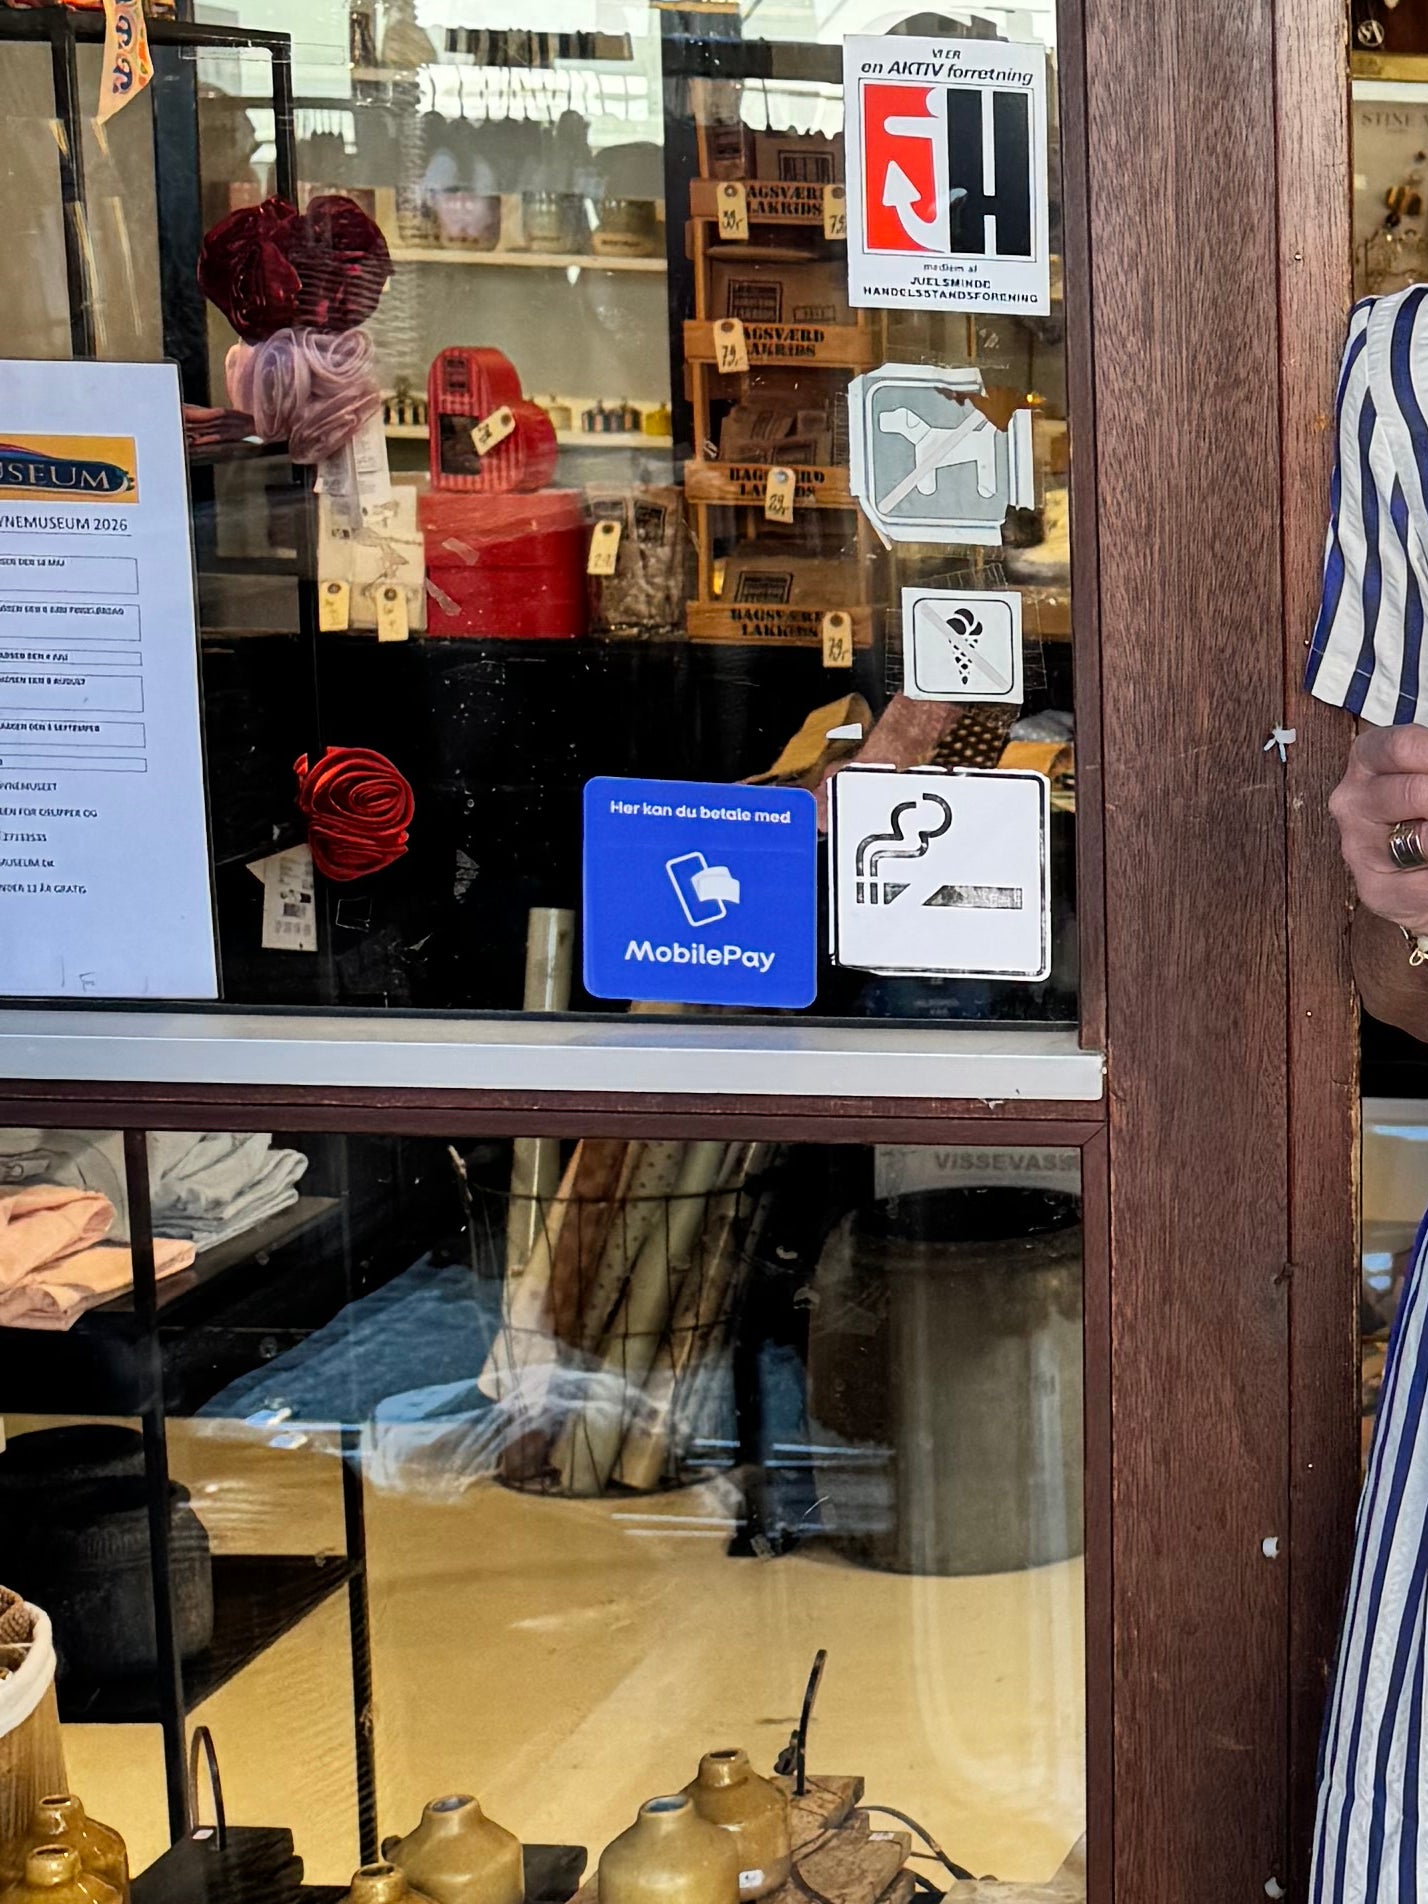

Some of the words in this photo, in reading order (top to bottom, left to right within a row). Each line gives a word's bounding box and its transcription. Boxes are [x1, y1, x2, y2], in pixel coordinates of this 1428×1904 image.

[887, 61, 944, 77] AKTIV
[947, 64, 1034, 86] forretning
[749, 185, 823, 200] AGSVÆR
[911, 277, 991, 289] JUELSMINDE
[863, 286, 1038, 303] HANDELSSTANDSFORENING
[743, 327, 825, 342] AGSVÆRD
[749, 343, 816, 357] AKRIDS
[93, 518, 128, 531] 2026
[610, 800, 640, 815] Her
[643, 802, 672, 816] kan
[675, 805, 697, 818] du
[700, 806, 751, 822] betale
[755, 811, 791, 824] med
[624, 940, 776, 974] MobilePay
